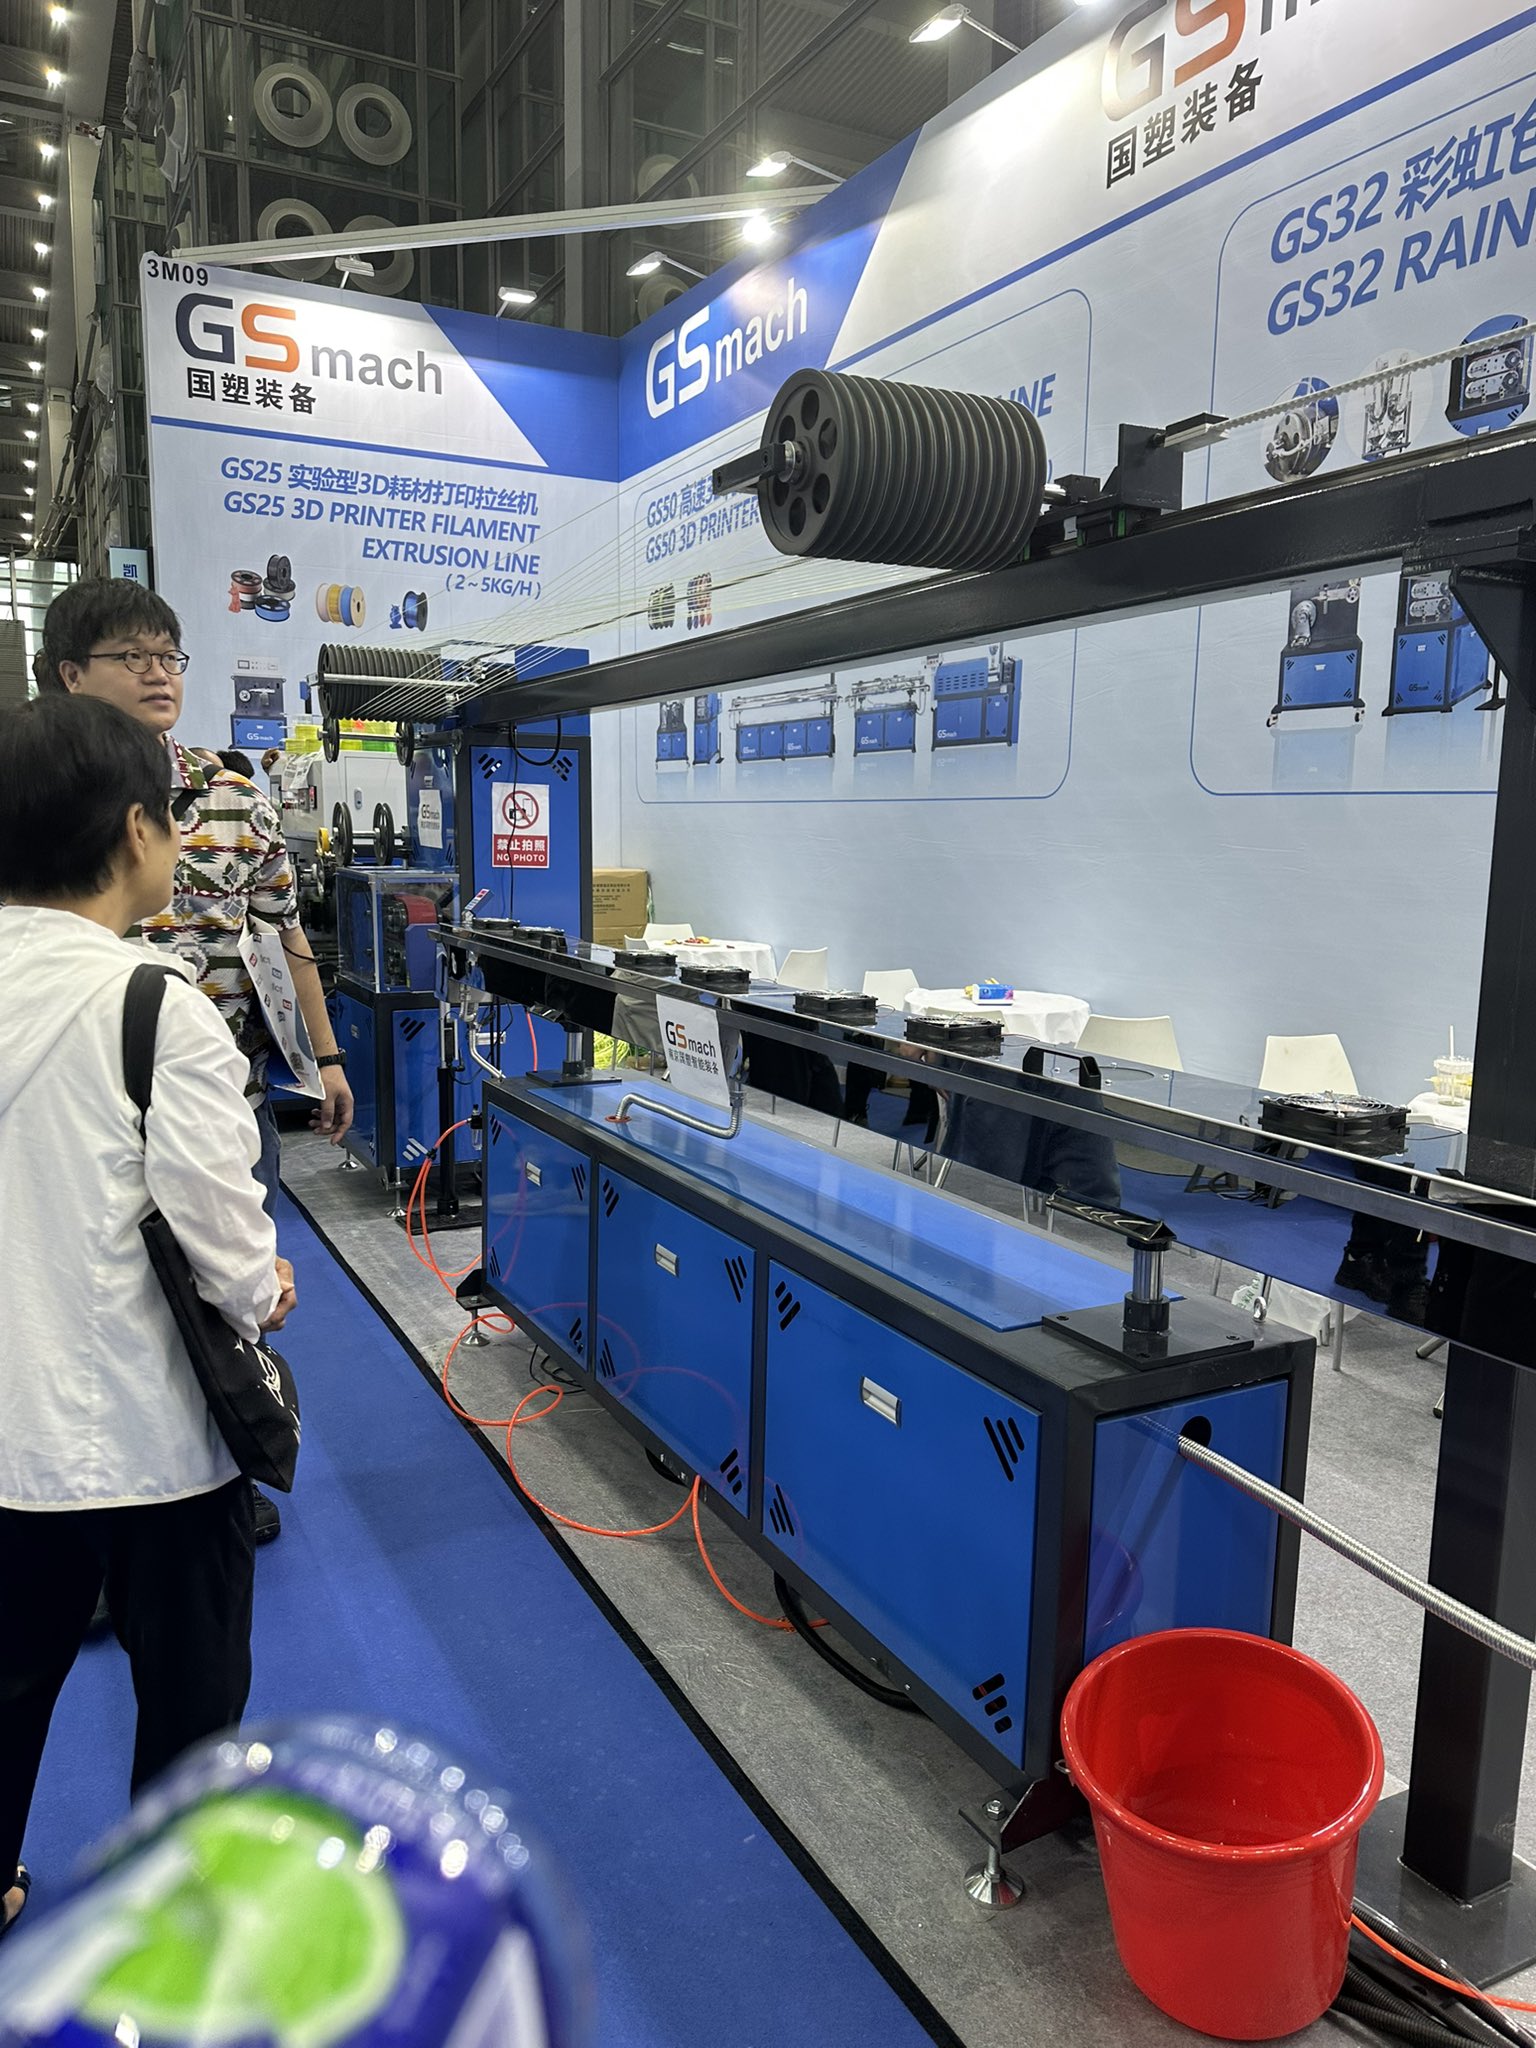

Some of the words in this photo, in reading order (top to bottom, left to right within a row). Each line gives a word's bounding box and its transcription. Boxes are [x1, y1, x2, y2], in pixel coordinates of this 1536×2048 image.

[1106, 58, 1263, 189] 国塑装备
[1271, 171, 1389, 264] GS32
[147, 258, 209, 287] 3M09
[1267, 248, 1386, 336] GS32
[1394, 186, 1536, 293] RAIN
[186, 367, 317, 415] 国塑装备
[221, 457, 283, 485] GS25
[288, 463, 539, 517] 实验型3D耗材打印拉丝机
[647, 491, 678, 528] GS50
[223, 491, 285, 517] GS25
[291, 498, 324, 521] 3D
[329, 502, 426, 533] PRINTER
[431, 513, 541, 545] FILAMENT
[646, 528, 676, 563] GS50
[679, 521, 697, 552] 3D
[699, 495, 760, 544] PRINTER
[362, 538, 488, 570] EXTRUSION
[494, 550, 541, 575] LINE
[496, 838, 546, 851] 禁止拍照
[496, 853, 510, 862] NO
[513, 853, 546, 862] PHOTO
[665, 1020, 717, 1058] GSmach
